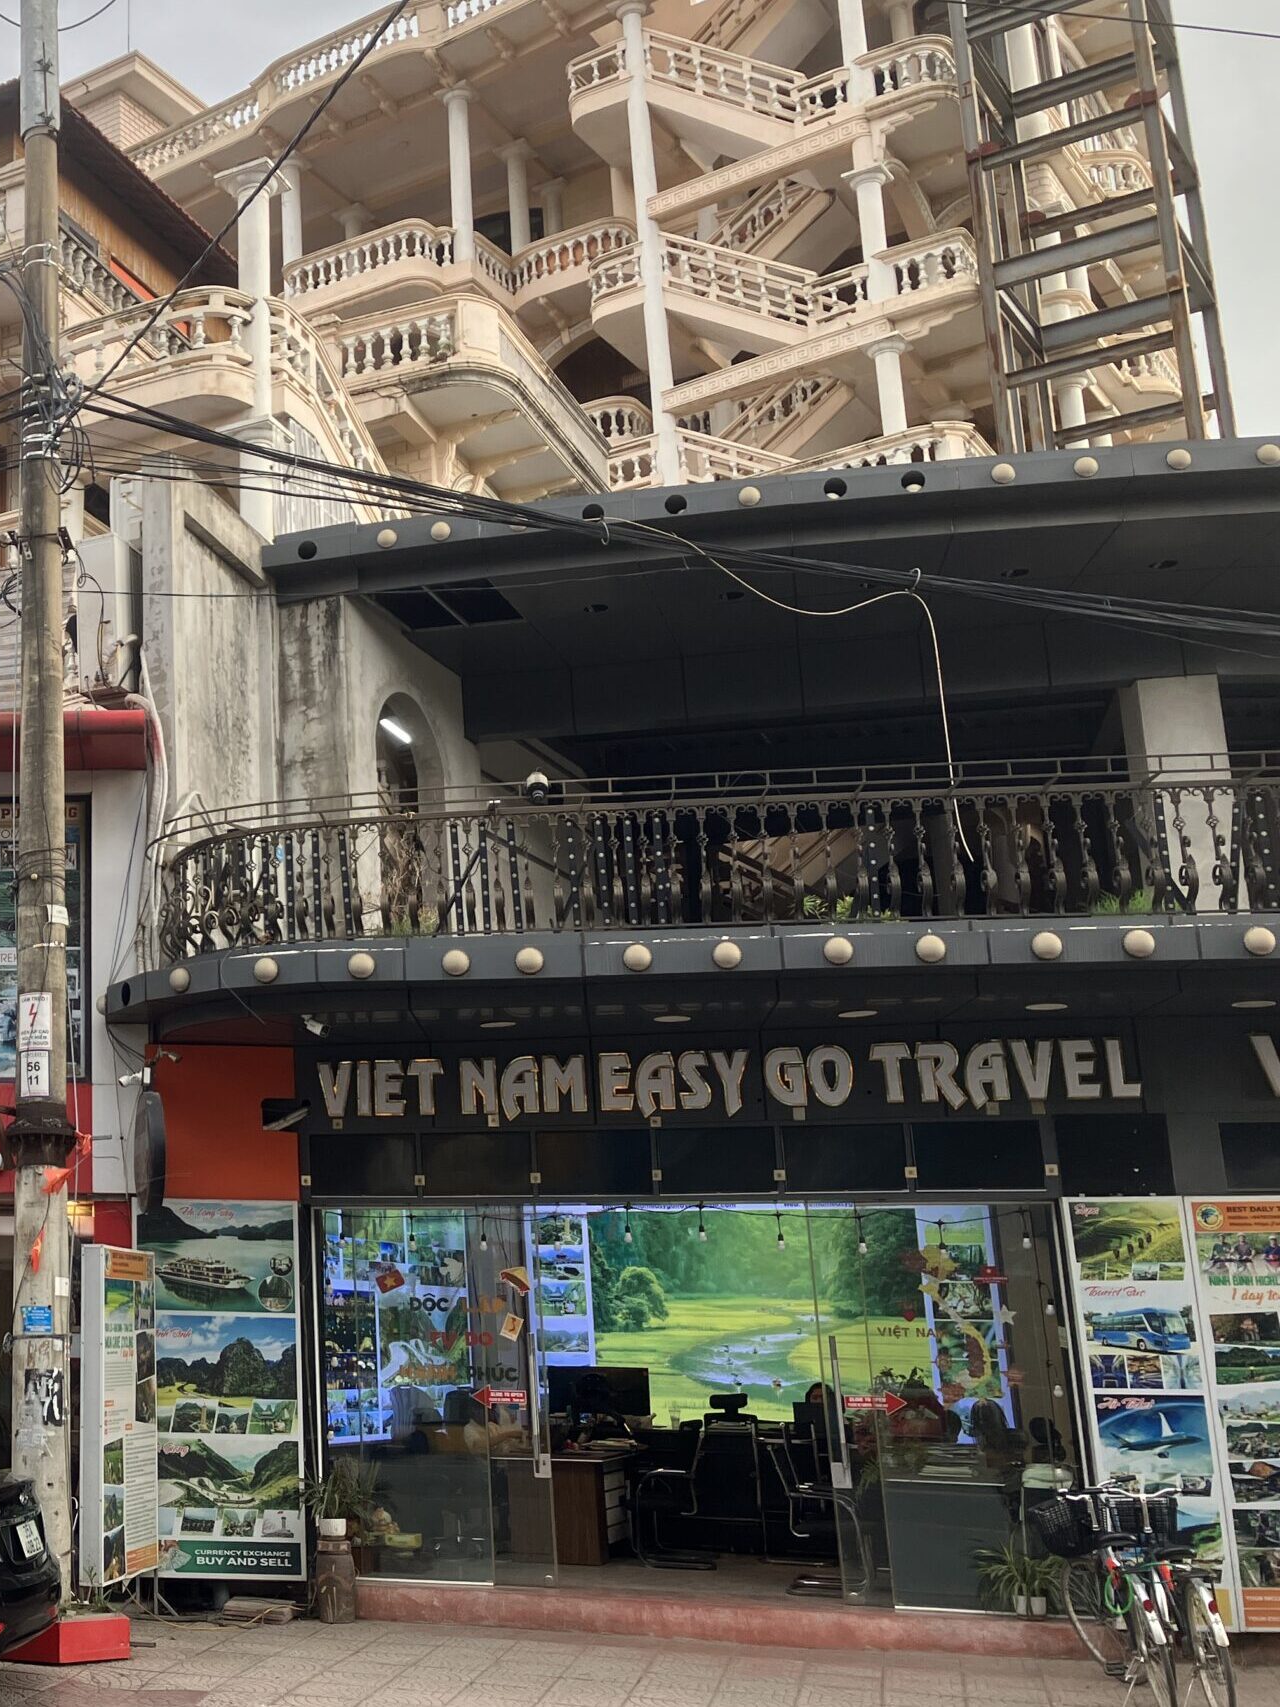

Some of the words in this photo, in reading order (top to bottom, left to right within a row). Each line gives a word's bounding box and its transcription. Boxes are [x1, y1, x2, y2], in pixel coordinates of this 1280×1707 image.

[27, 1062, 41, 1072] 56
[28, 1076, 40, 1086] 11
[317, 1057, 445, 1118] VIET
[458, 1054, 588, 1122] NAM
[597, 1050, 749, 1119] EASY
[763, 1045, 854, 1108] GO
[868, 1037, 1144, 1112] TRAVEL
[877, 1324, 910, 1340] VIỆT
[194, 1549, 241, 1557] CURRENCY
[243, 1550, 292, 1558] EXCHANGE
[196, 1556, 225, 1566] BUY
[227, 1557, 258, 1567] AND
[260, 1557, 292, 1568] SELL
